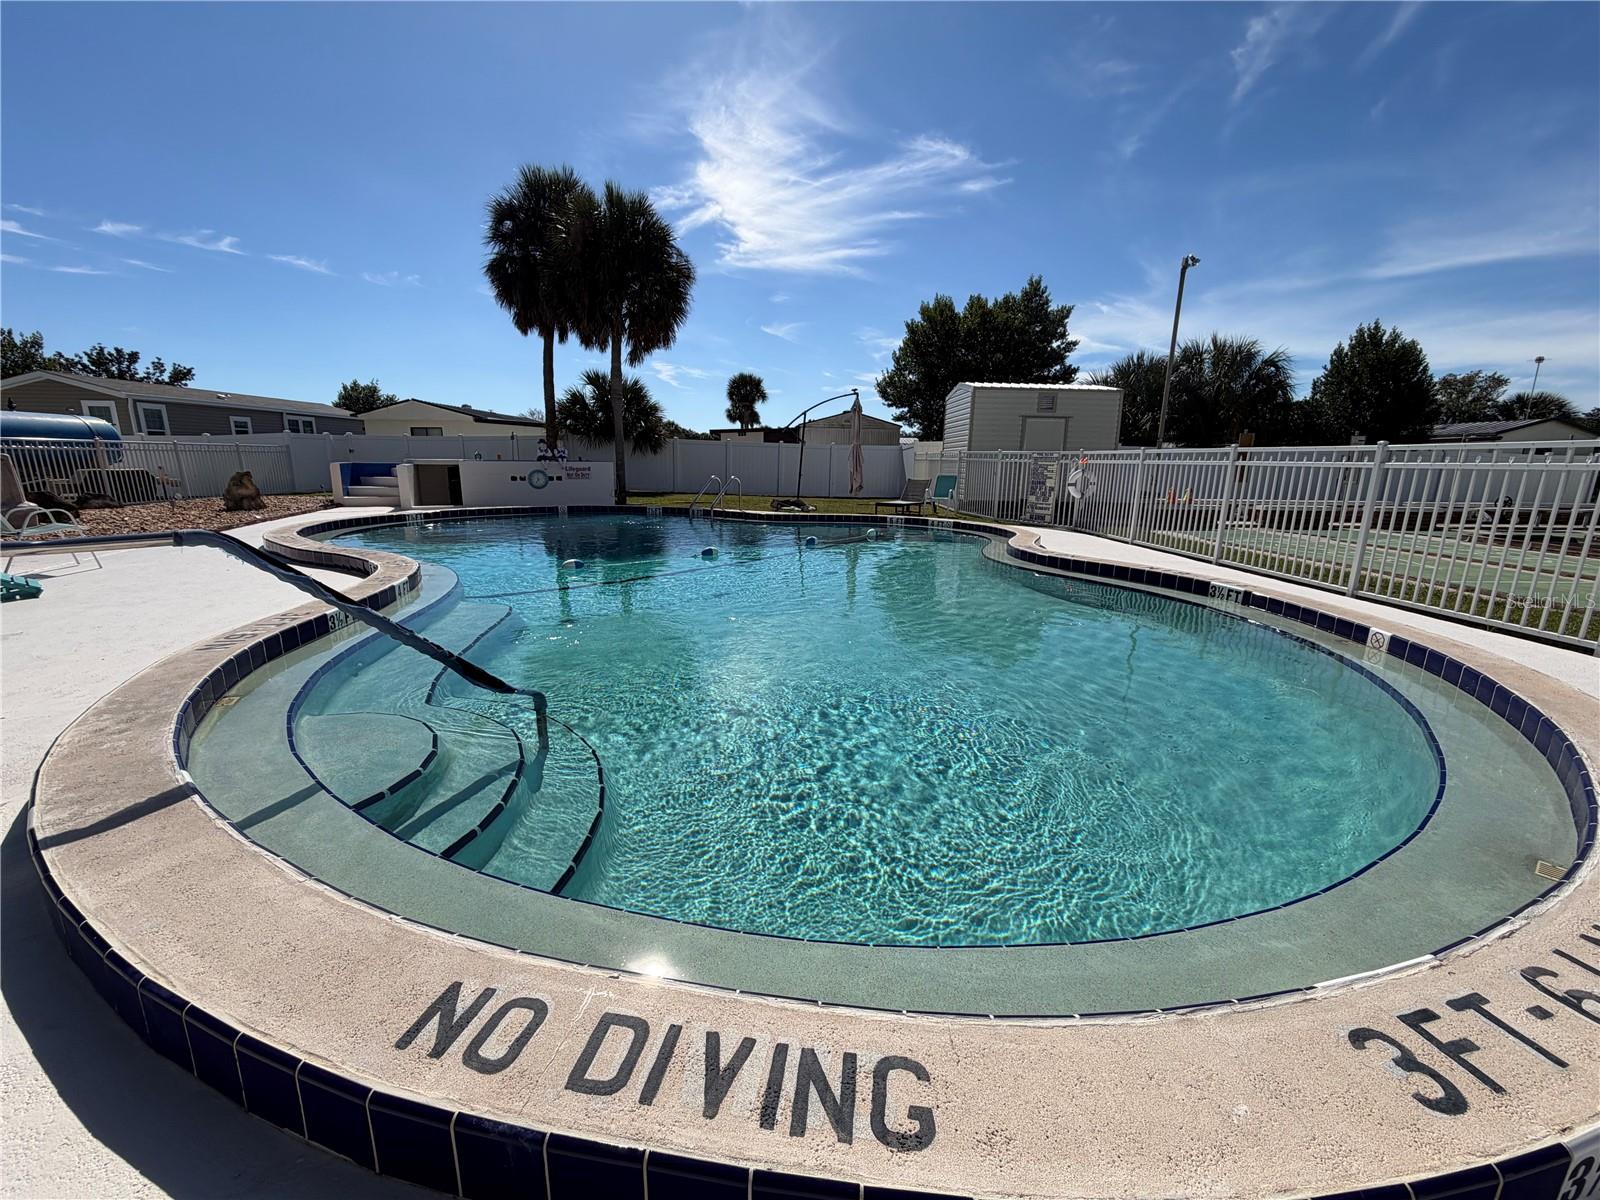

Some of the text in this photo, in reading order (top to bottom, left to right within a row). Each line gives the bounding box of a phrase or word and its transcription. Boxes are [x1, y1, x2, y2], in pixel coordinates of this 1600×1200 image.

[1226, 588, 1241, 604] FT
[394, 980, 938, 1153] NO DIVING
